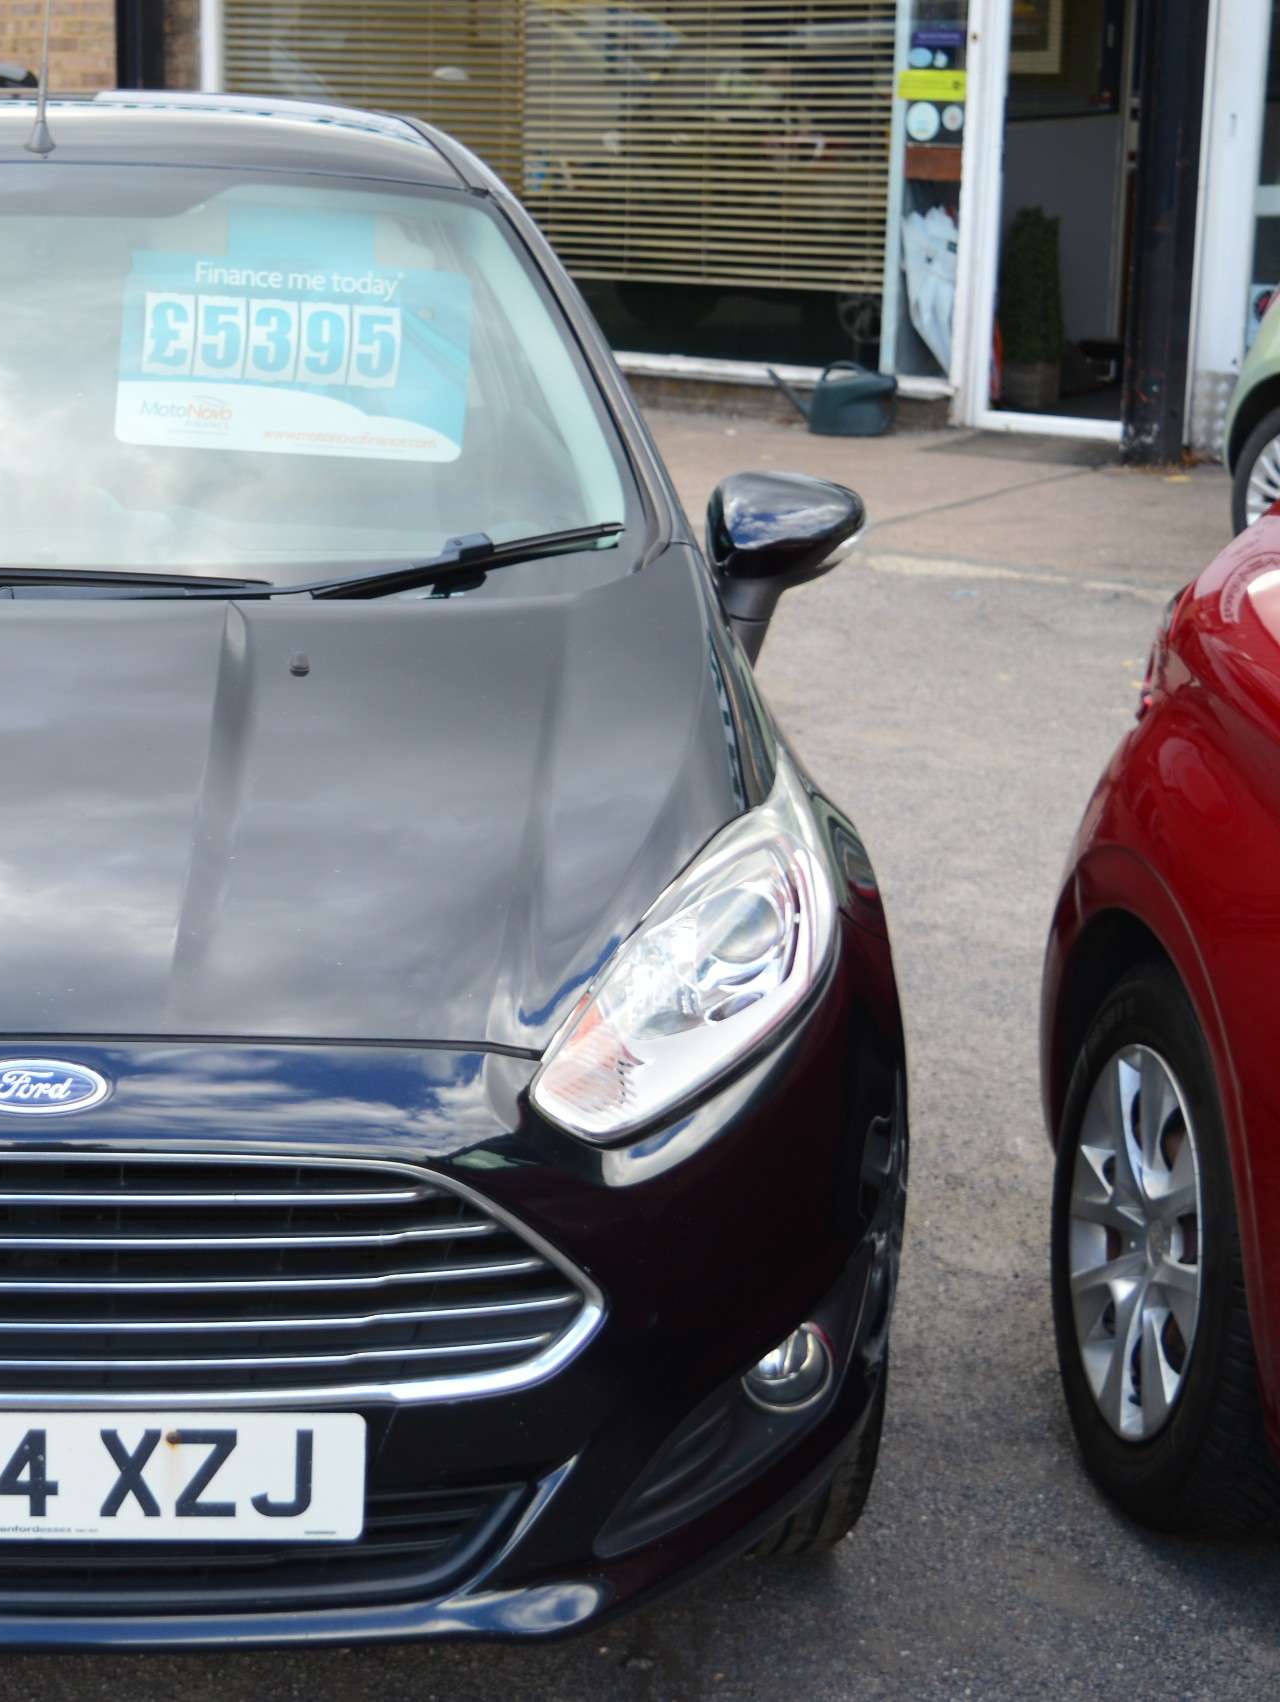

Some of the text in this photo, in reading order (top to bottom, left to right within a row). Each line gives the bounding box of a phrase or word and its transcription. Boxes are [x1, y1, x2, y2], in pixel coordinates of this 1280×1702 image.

[195, 261, 282, 289] Finance
[288, 273, 325, 290] me
[150, 301, 397, 379] £5395
[139, 400, 232, 422] MotoNovo
[100, 1428, 314, 1518] XZJ
